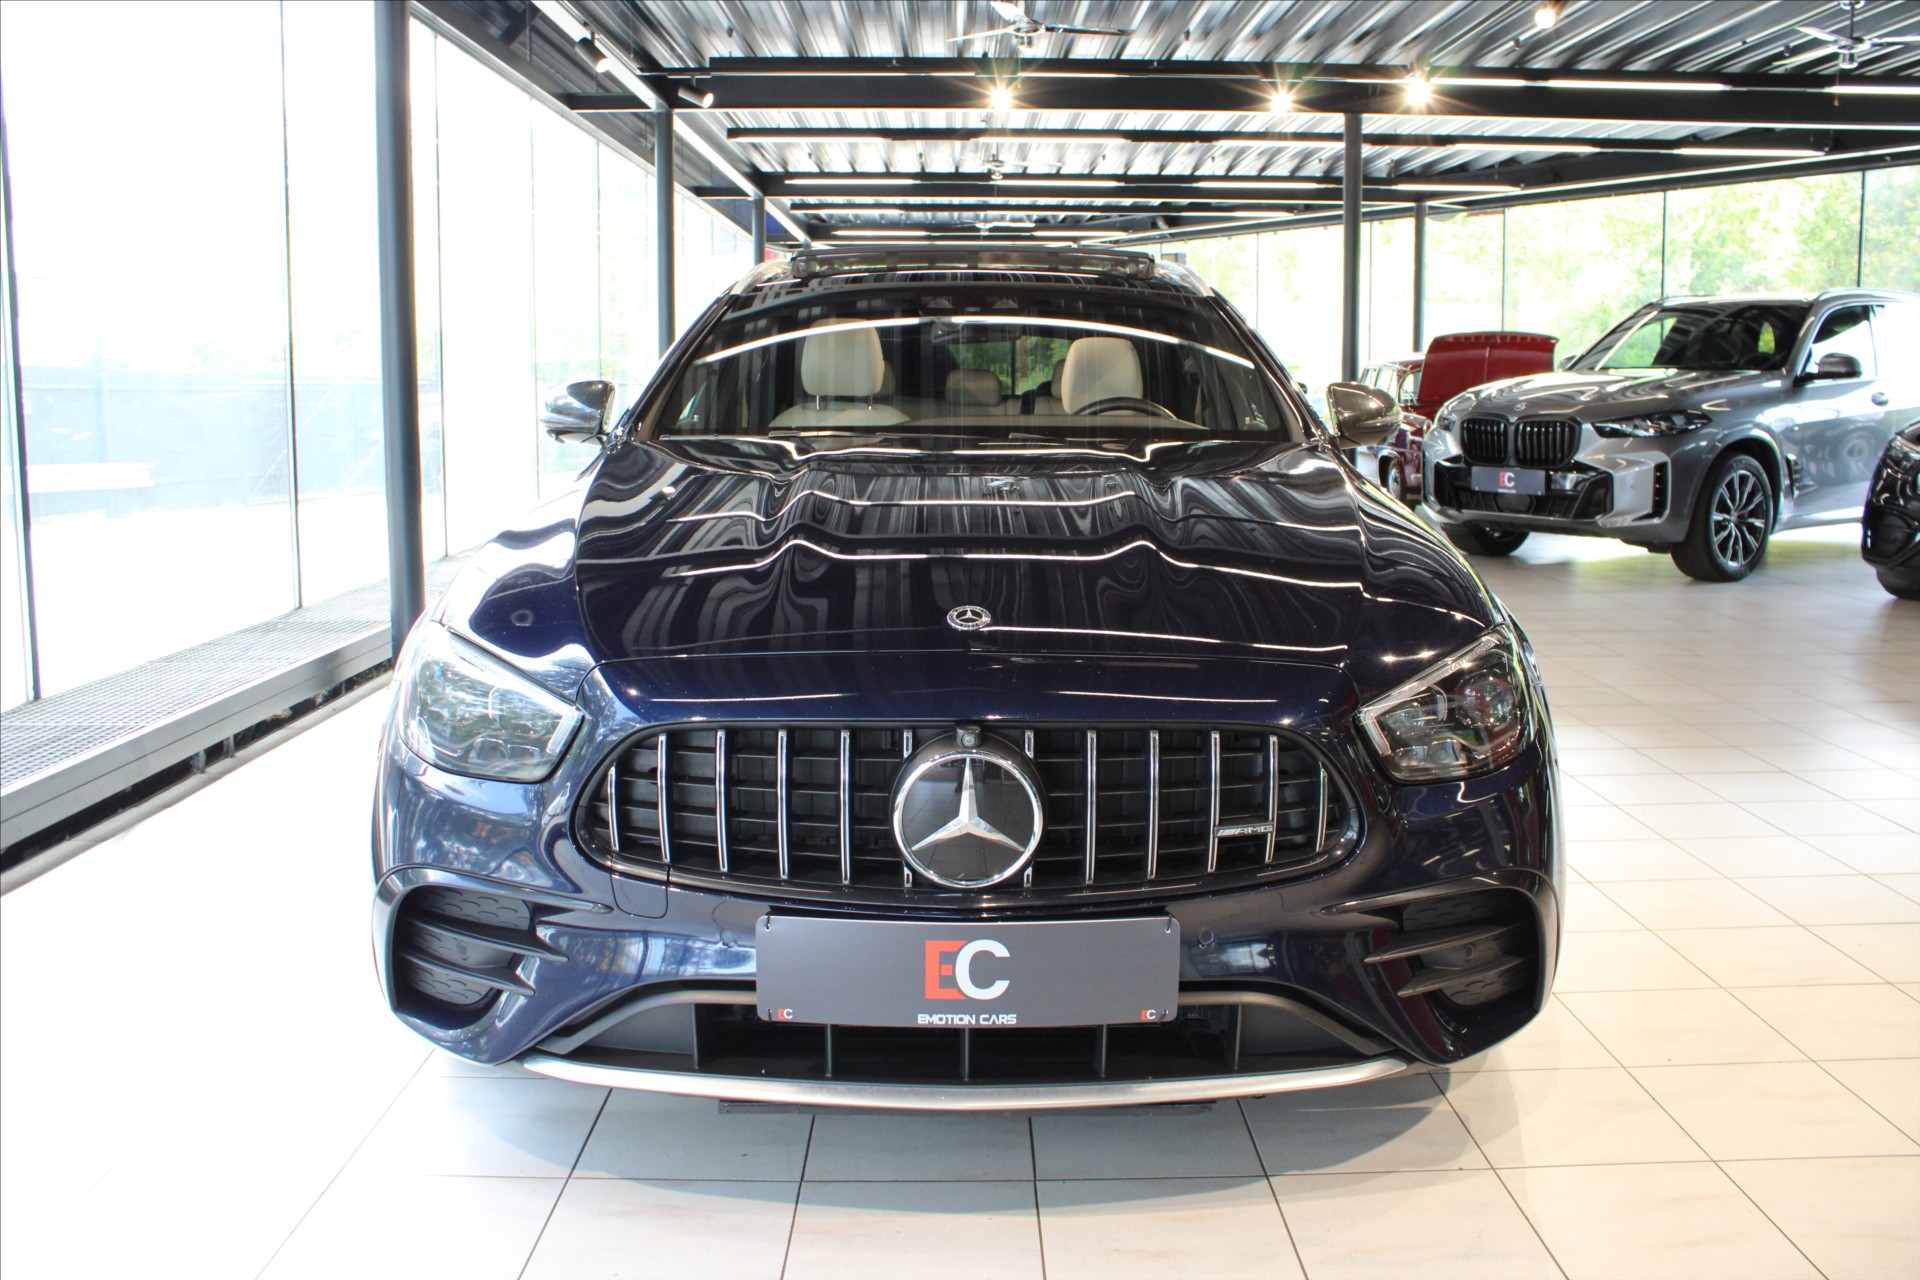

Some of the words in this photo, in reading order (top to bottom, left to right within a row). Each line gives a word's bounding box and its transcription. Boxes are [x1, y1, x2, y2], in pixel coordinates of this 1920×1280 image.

[1234, 825, 1273, 835] AMG
[925, 939, 1010, 1000] EC
[777, 1008, 793, 1019] EC
[917, 1013, 976, 1025] EMOTION
[979, 1013, 1017, 1025] CARS
[1141, 1009, 1157, 1020] EC
